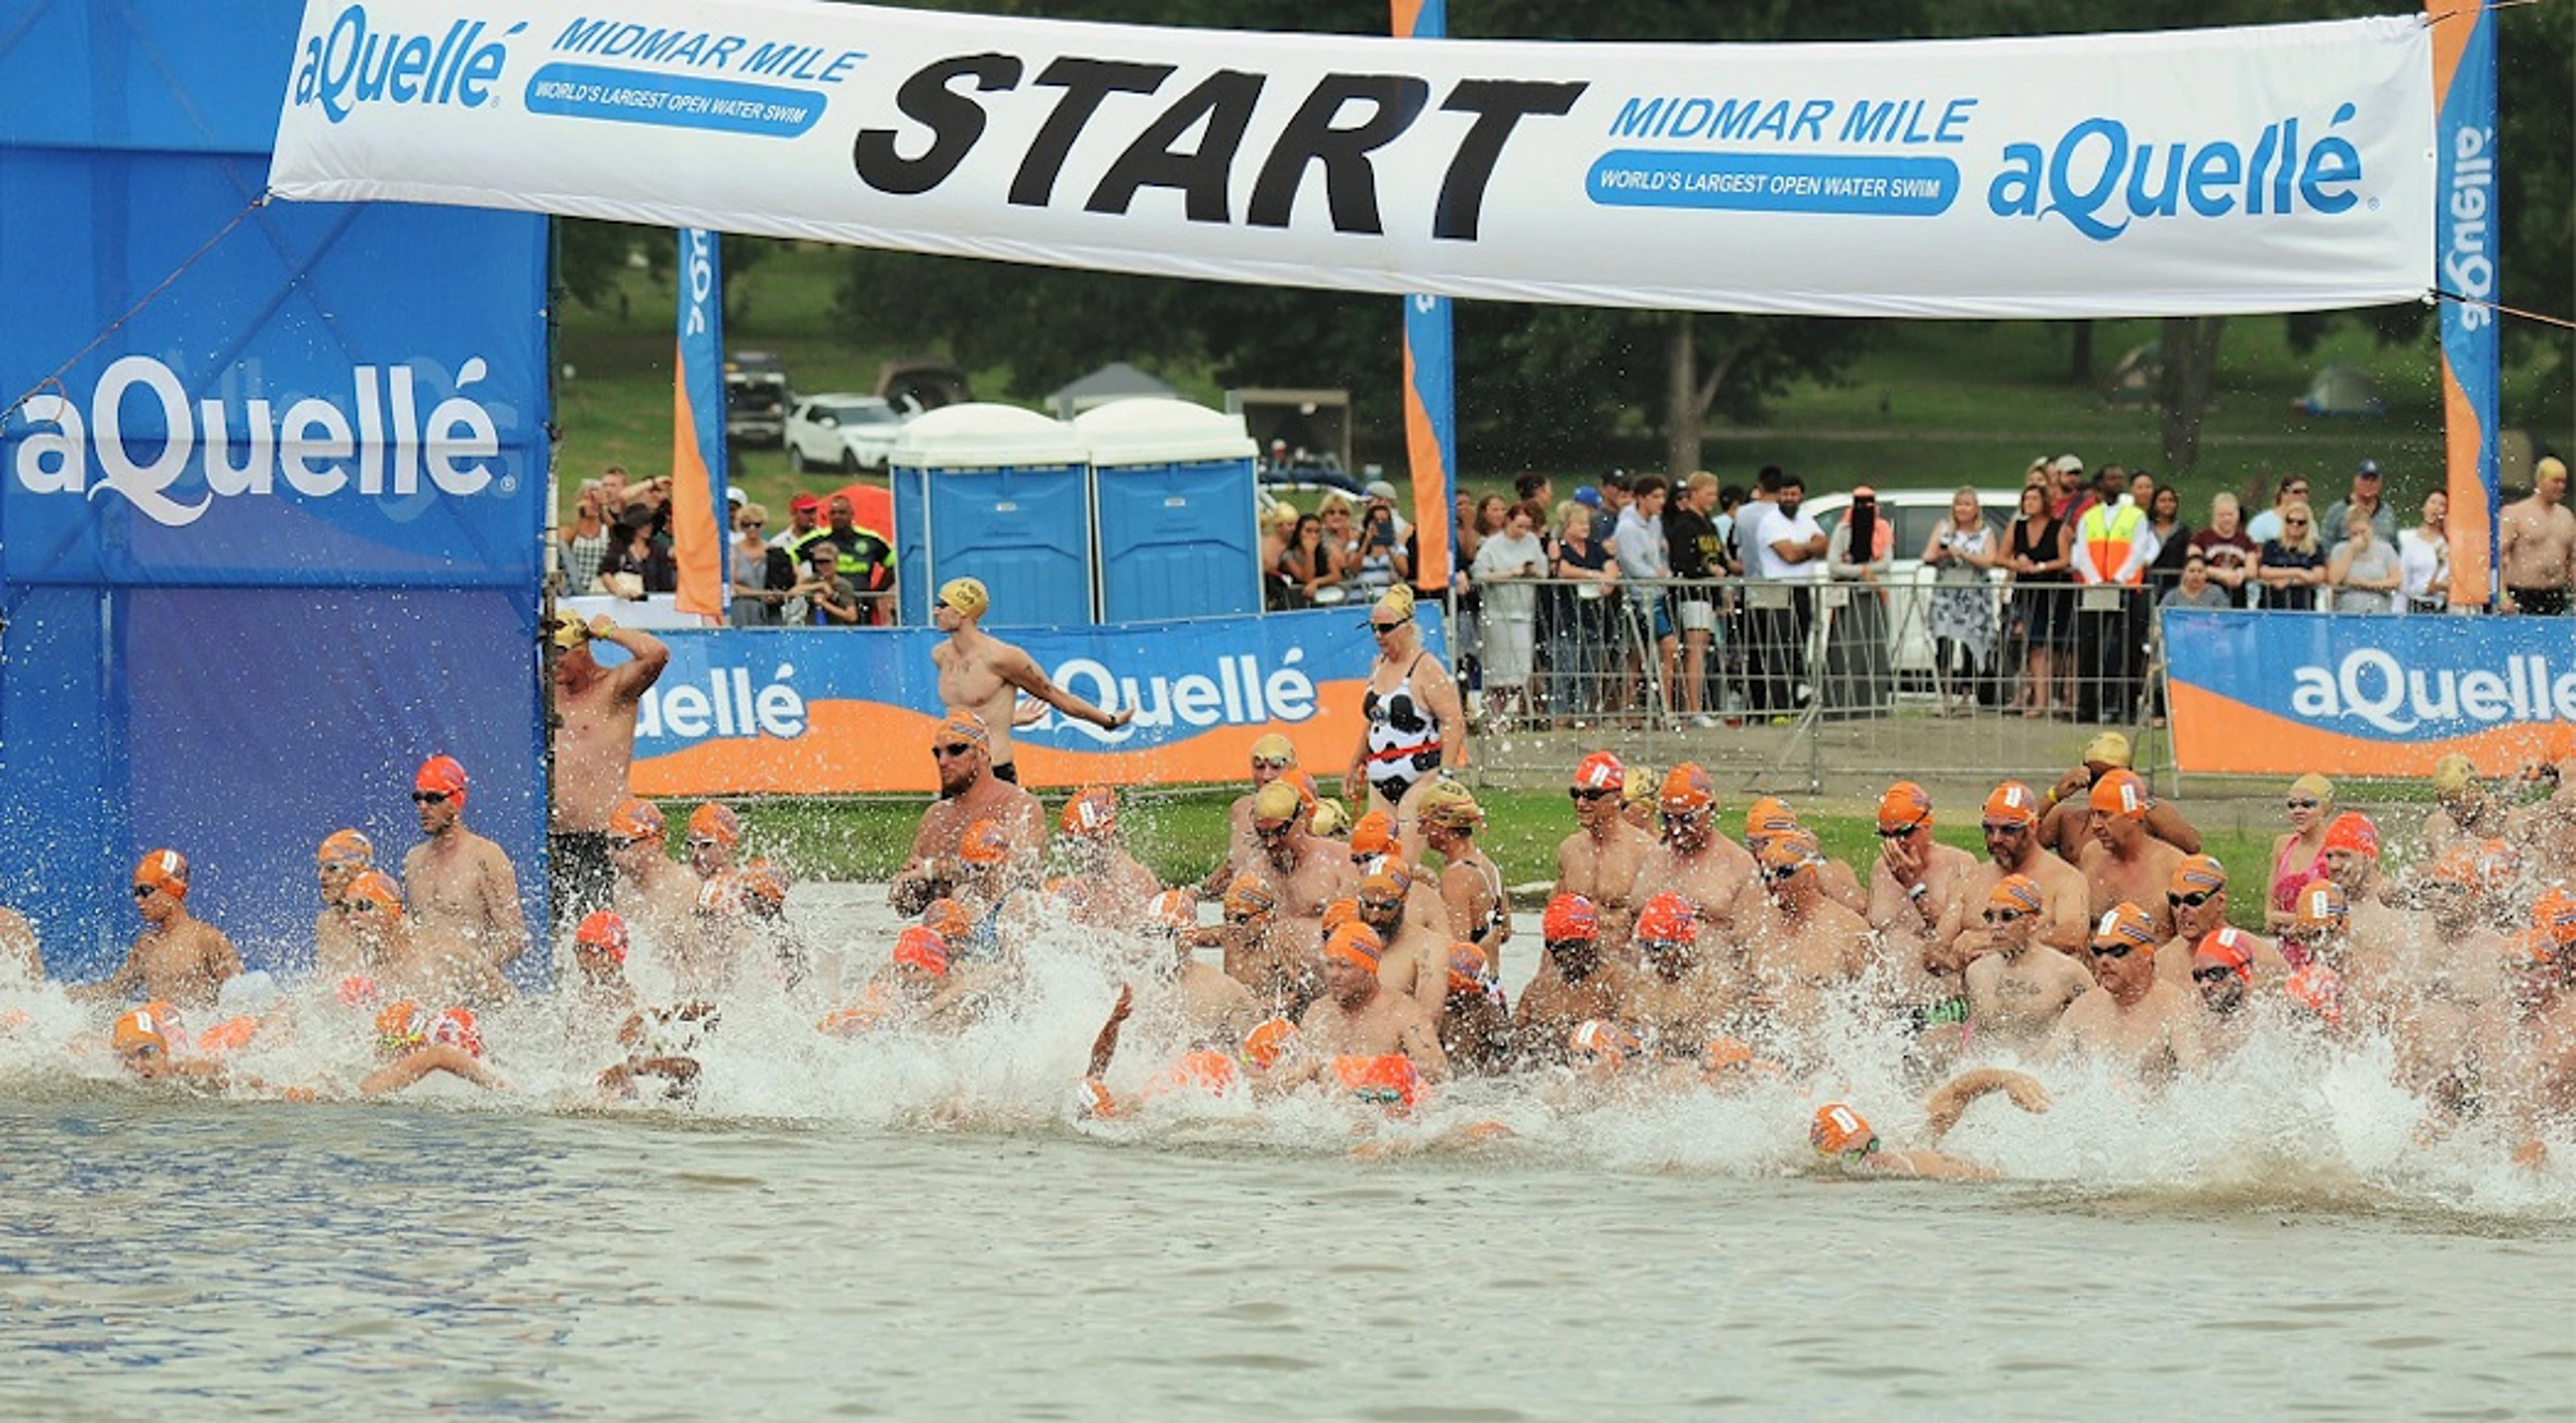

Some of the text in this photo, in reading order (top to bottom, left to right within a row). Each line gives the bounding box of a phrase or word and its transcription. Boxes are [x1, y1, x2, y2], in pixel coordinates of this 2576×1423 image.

[295, 3, 529, 125] aQuellé
[551, 17, 869, 84] MIDMAR MILE
[535, 81, 809, 124] WORLD'S LARGEST OPEN WATER SWIM
[853, 52, 1591, 242] START
[1609, 97, 1979, 144] MIDMAR MILE
[1600, 169, 1942, 199] WORLD'S LARGEST OPEN WATER SWIM
[1986, 101, 2363, 242] aQuellé
[16, 356, 498, 527] aQuellé
